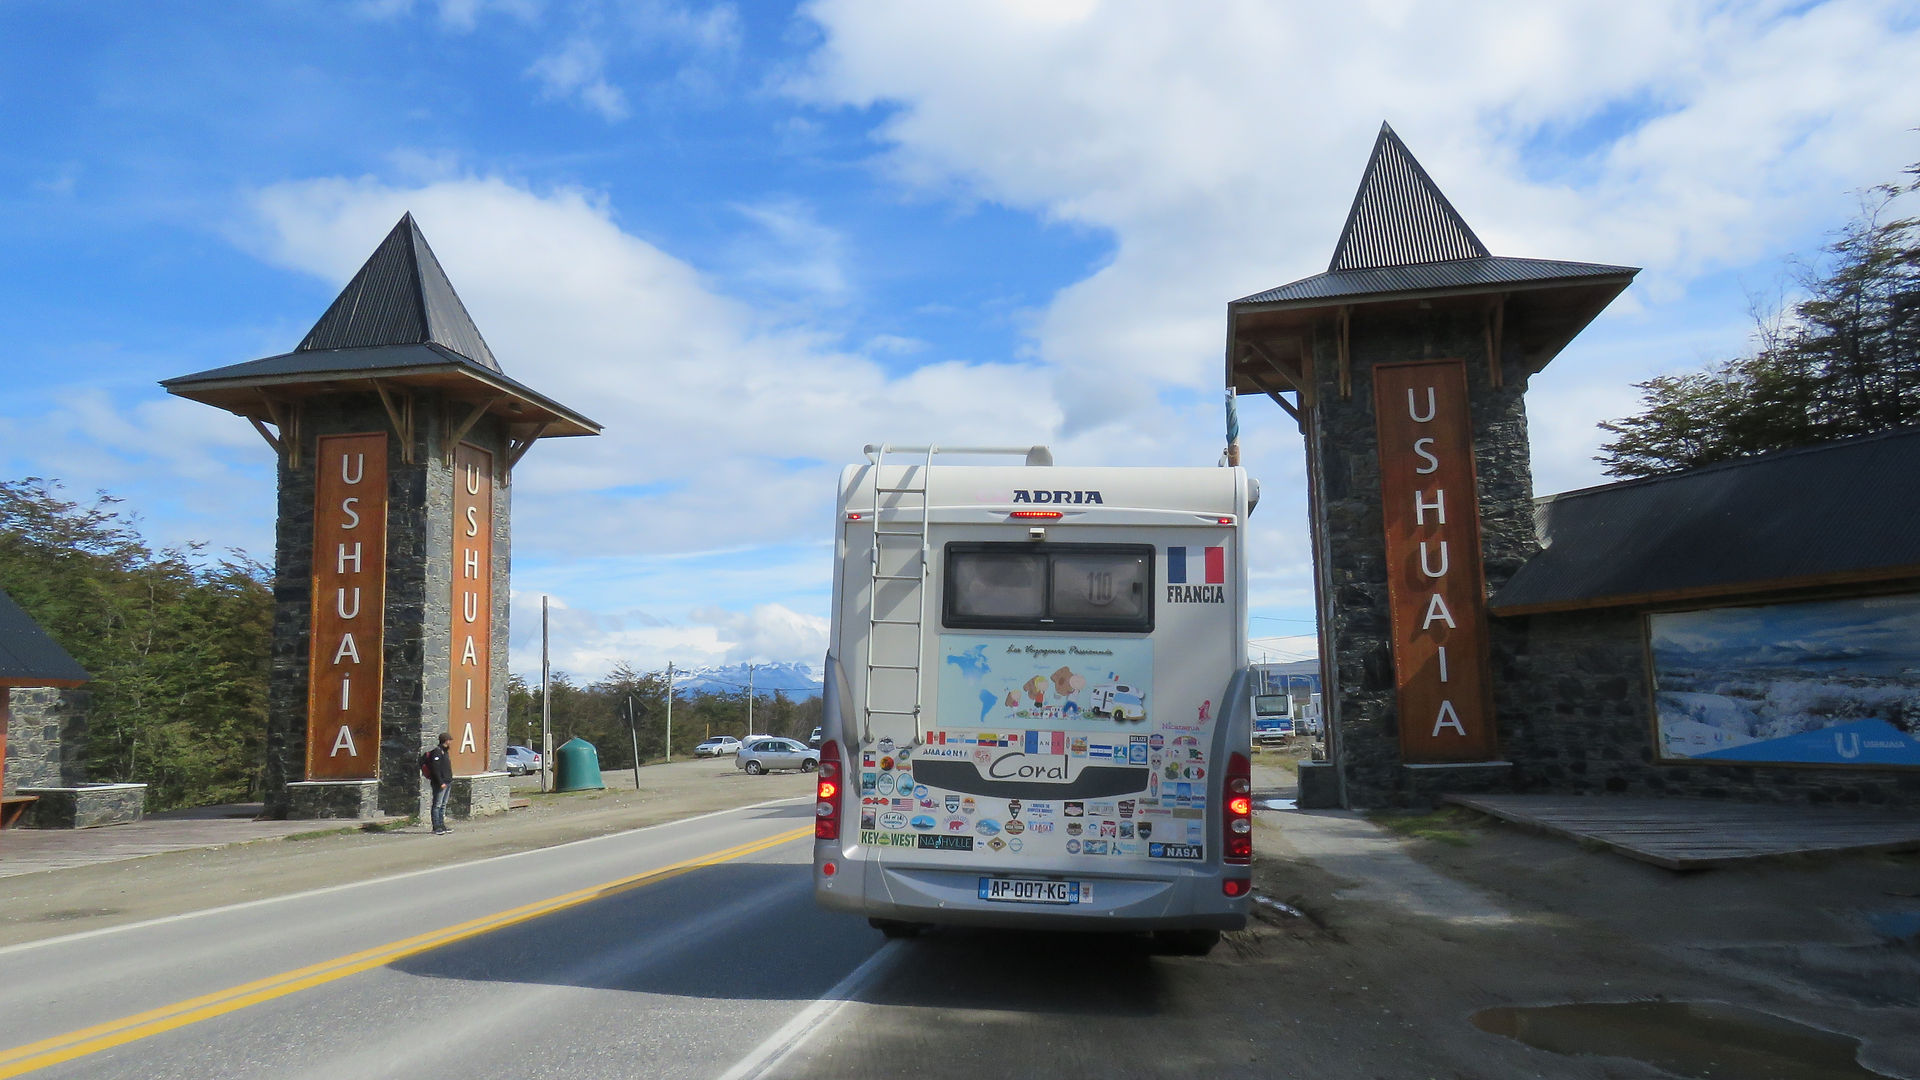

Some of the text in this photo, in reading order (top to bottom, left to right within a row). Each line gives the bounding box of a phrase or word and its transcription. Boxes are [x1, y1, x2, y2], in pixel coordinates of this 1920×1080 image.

[1013, 490, 1103, 504] ADRIA
[1407, 387, 1467, 737] USHUAIA
[1088, 571, 1112, 600] 110
[1167, 586, 1225, 603] FRANCIA
[460, 463, 480, 755] USHUAIA
[989, 752, 1068, 779] Coral
[861, 831, 916, 847] KEY WEST
[919, 835, 971, 849] NASHVILLE
[1166, 847, 1199, 858] NASA
[991, 880, 1067, 899] AP-007-KG
[1069, 893, 1078, 901] 06
